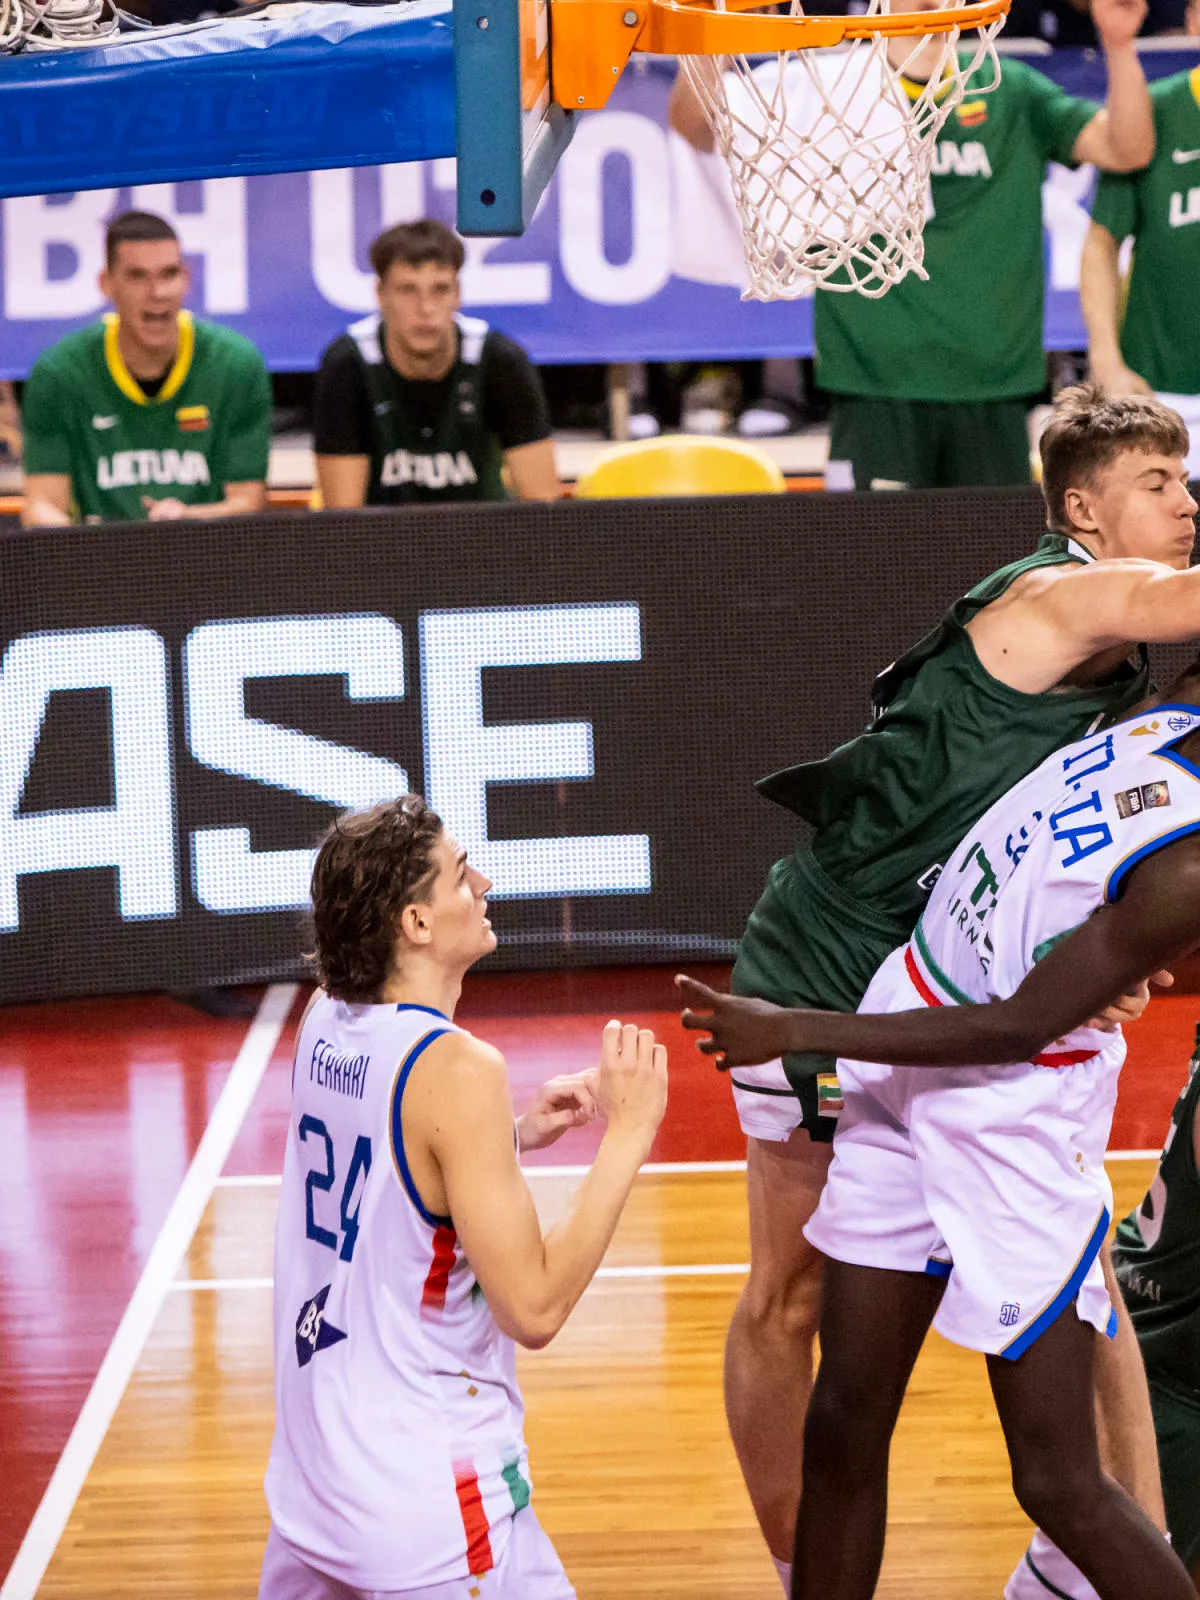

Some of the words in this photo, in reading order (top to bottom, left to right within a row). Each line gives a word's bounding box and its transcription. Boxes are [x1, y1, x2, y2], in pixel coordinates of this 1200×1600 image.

[97, 449, 211, 490] LIETUVA
[0, 601, 652, 932] ASE
[310, 1038, 370, 1100] FERRARI
[298, 1113, 372, 1263] 24
